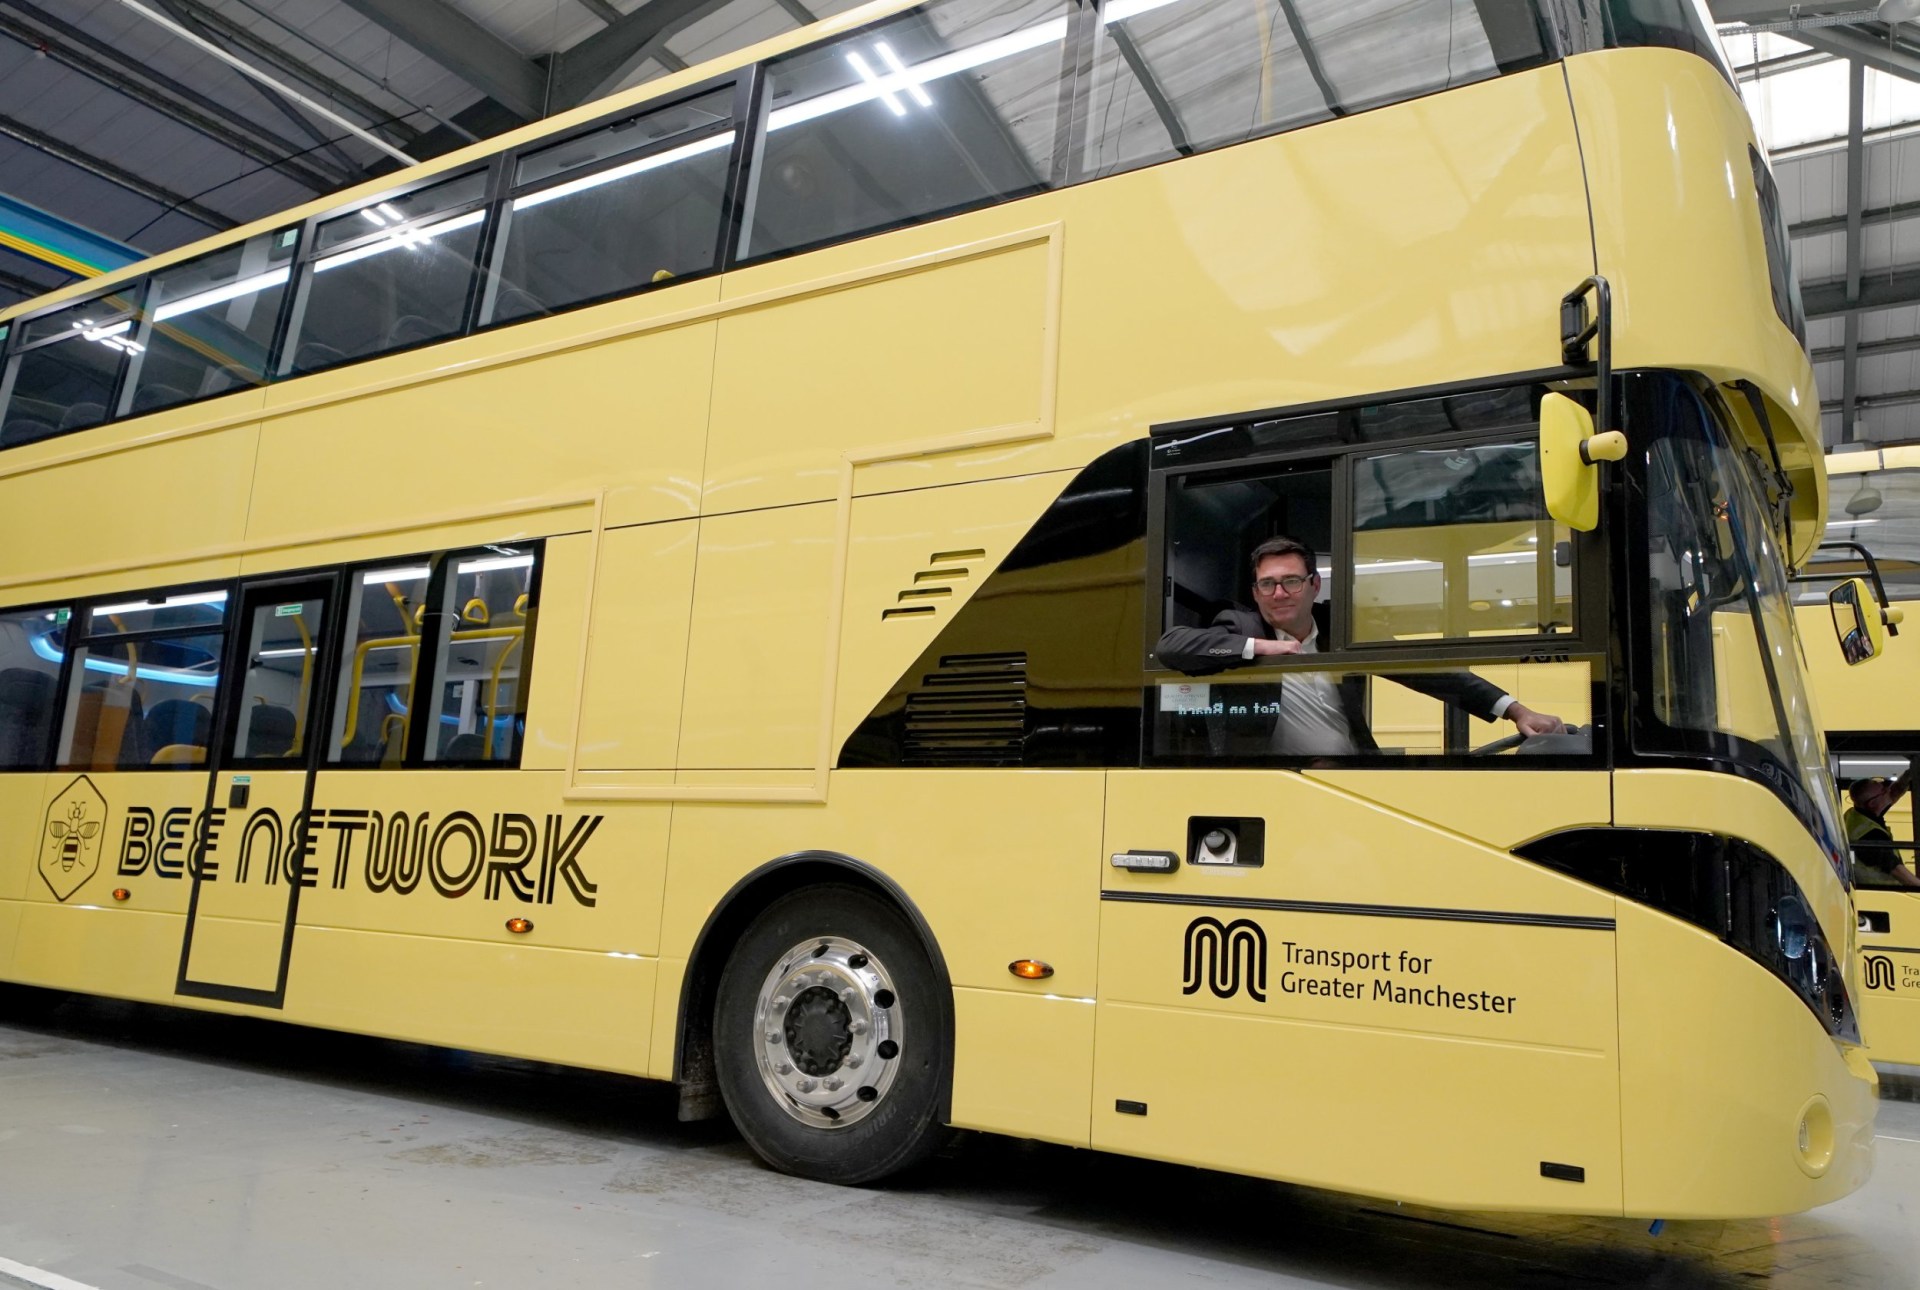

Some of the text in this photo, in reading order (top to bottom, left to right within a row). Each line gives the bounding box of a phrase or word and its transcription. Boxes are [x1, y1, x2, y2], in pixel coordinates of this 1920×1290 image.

[118, 805, 604, 907] BEE NETWORK
[1282, 942, 1432, 974] Transport for
[1281, 972, 1516, 1014] Greater Manchester
